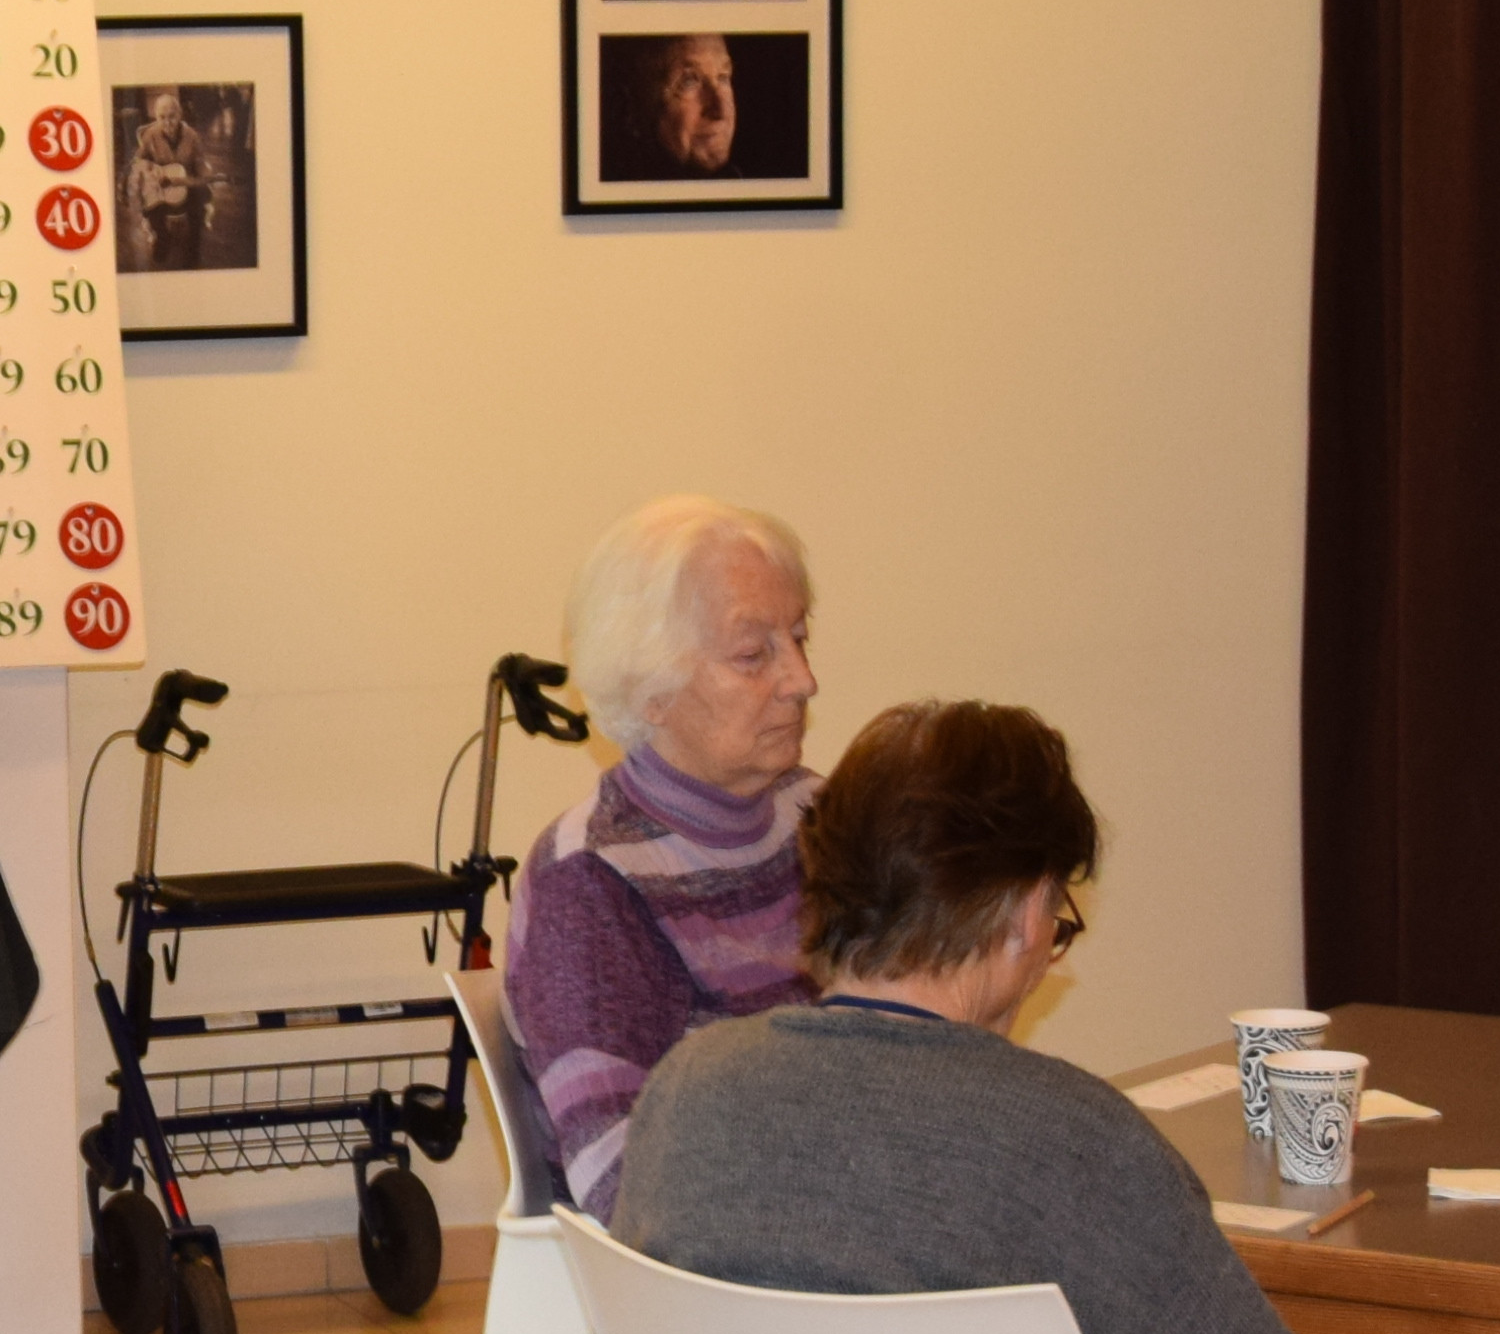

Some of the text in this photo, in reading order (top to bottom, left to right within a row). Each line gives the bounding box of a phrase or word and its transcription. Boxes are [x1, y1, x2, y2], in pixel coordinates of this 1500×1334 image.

[32, 44, 78, 78] 20
[38, 121, 86, 157] 30
[44, 198, 95, 236] 40
[51, 279, 97, 314] 50
[55, 358, 103, 393] 60
[61, 437, 109, 474] 70
[67, 517, 117, 554] 80
[72, 597, 122, 634] 90
